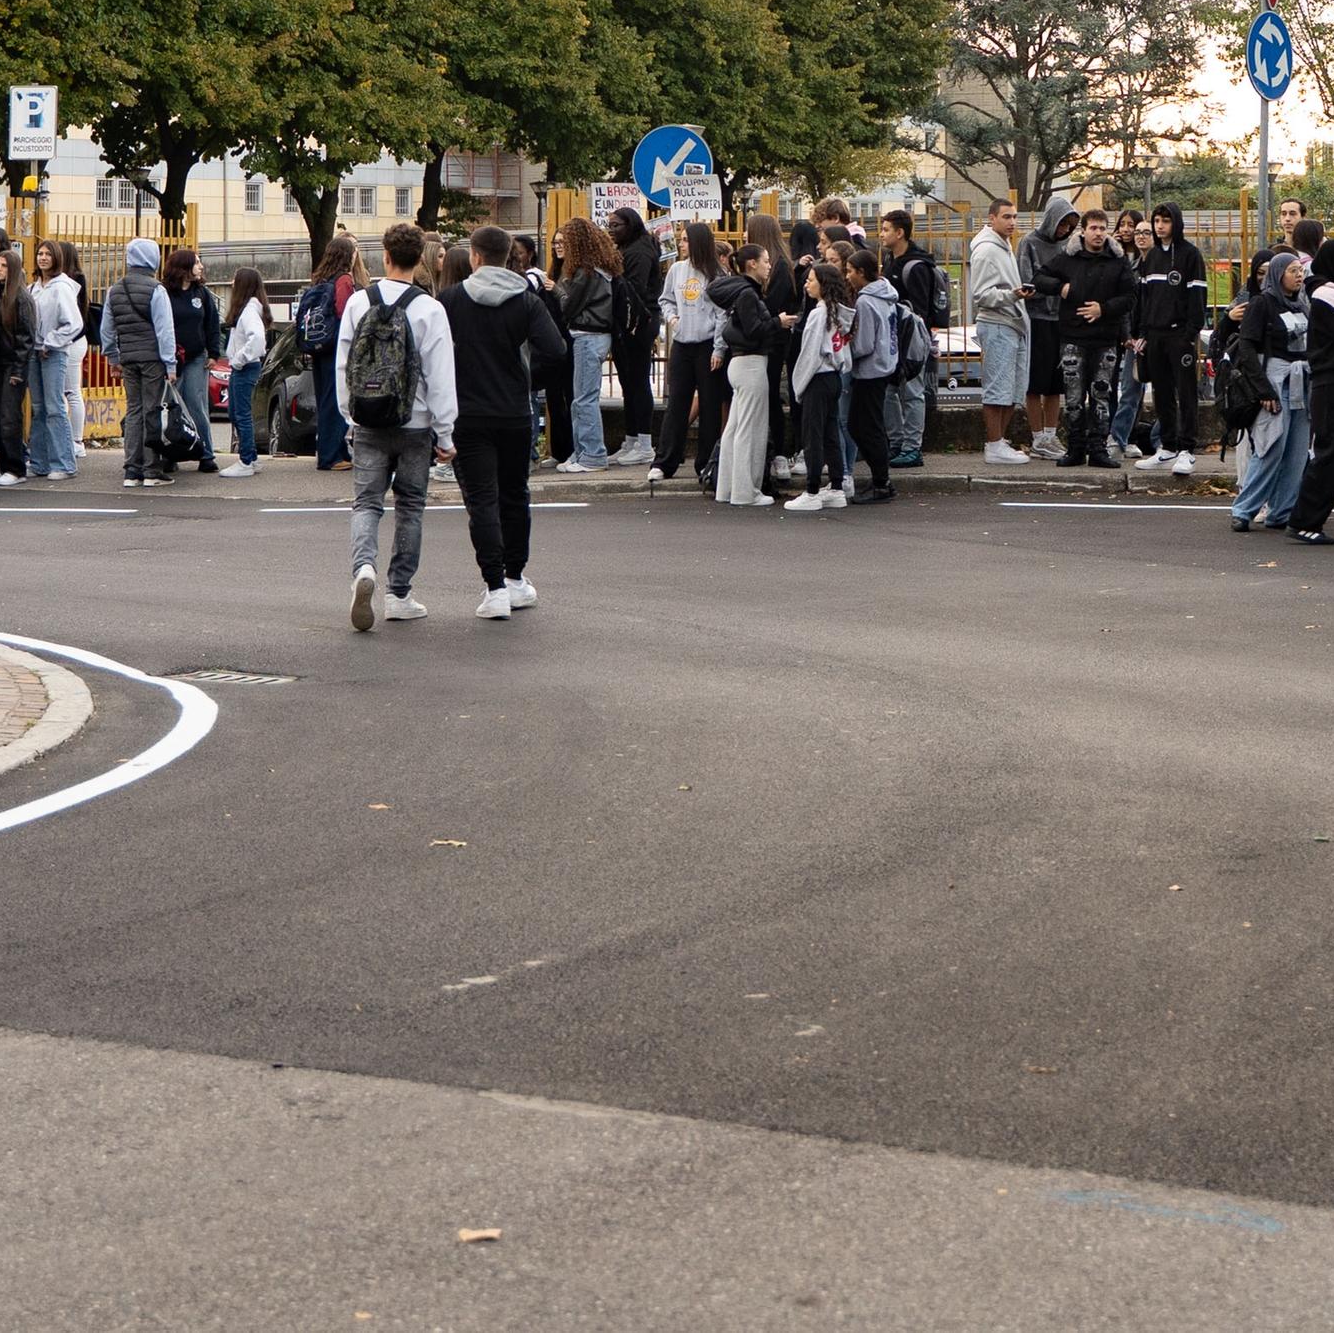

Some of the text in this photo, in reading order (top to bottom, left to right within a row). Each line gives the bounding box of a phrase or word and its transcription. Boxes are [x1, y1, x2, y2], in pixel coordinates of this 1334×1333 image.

[27, 97, 44, 127] P
[13, 136, 52, 144] PARCHEGGIO
[669, 178, 710, 187] VOGLIAMO
[595, 185, 639, 197] IL BAGNO
[674, 188, 696, 198] AULE
[603, 199, 614, 210] UN
[674, 199, 721, 209] FRIGORIFERI
